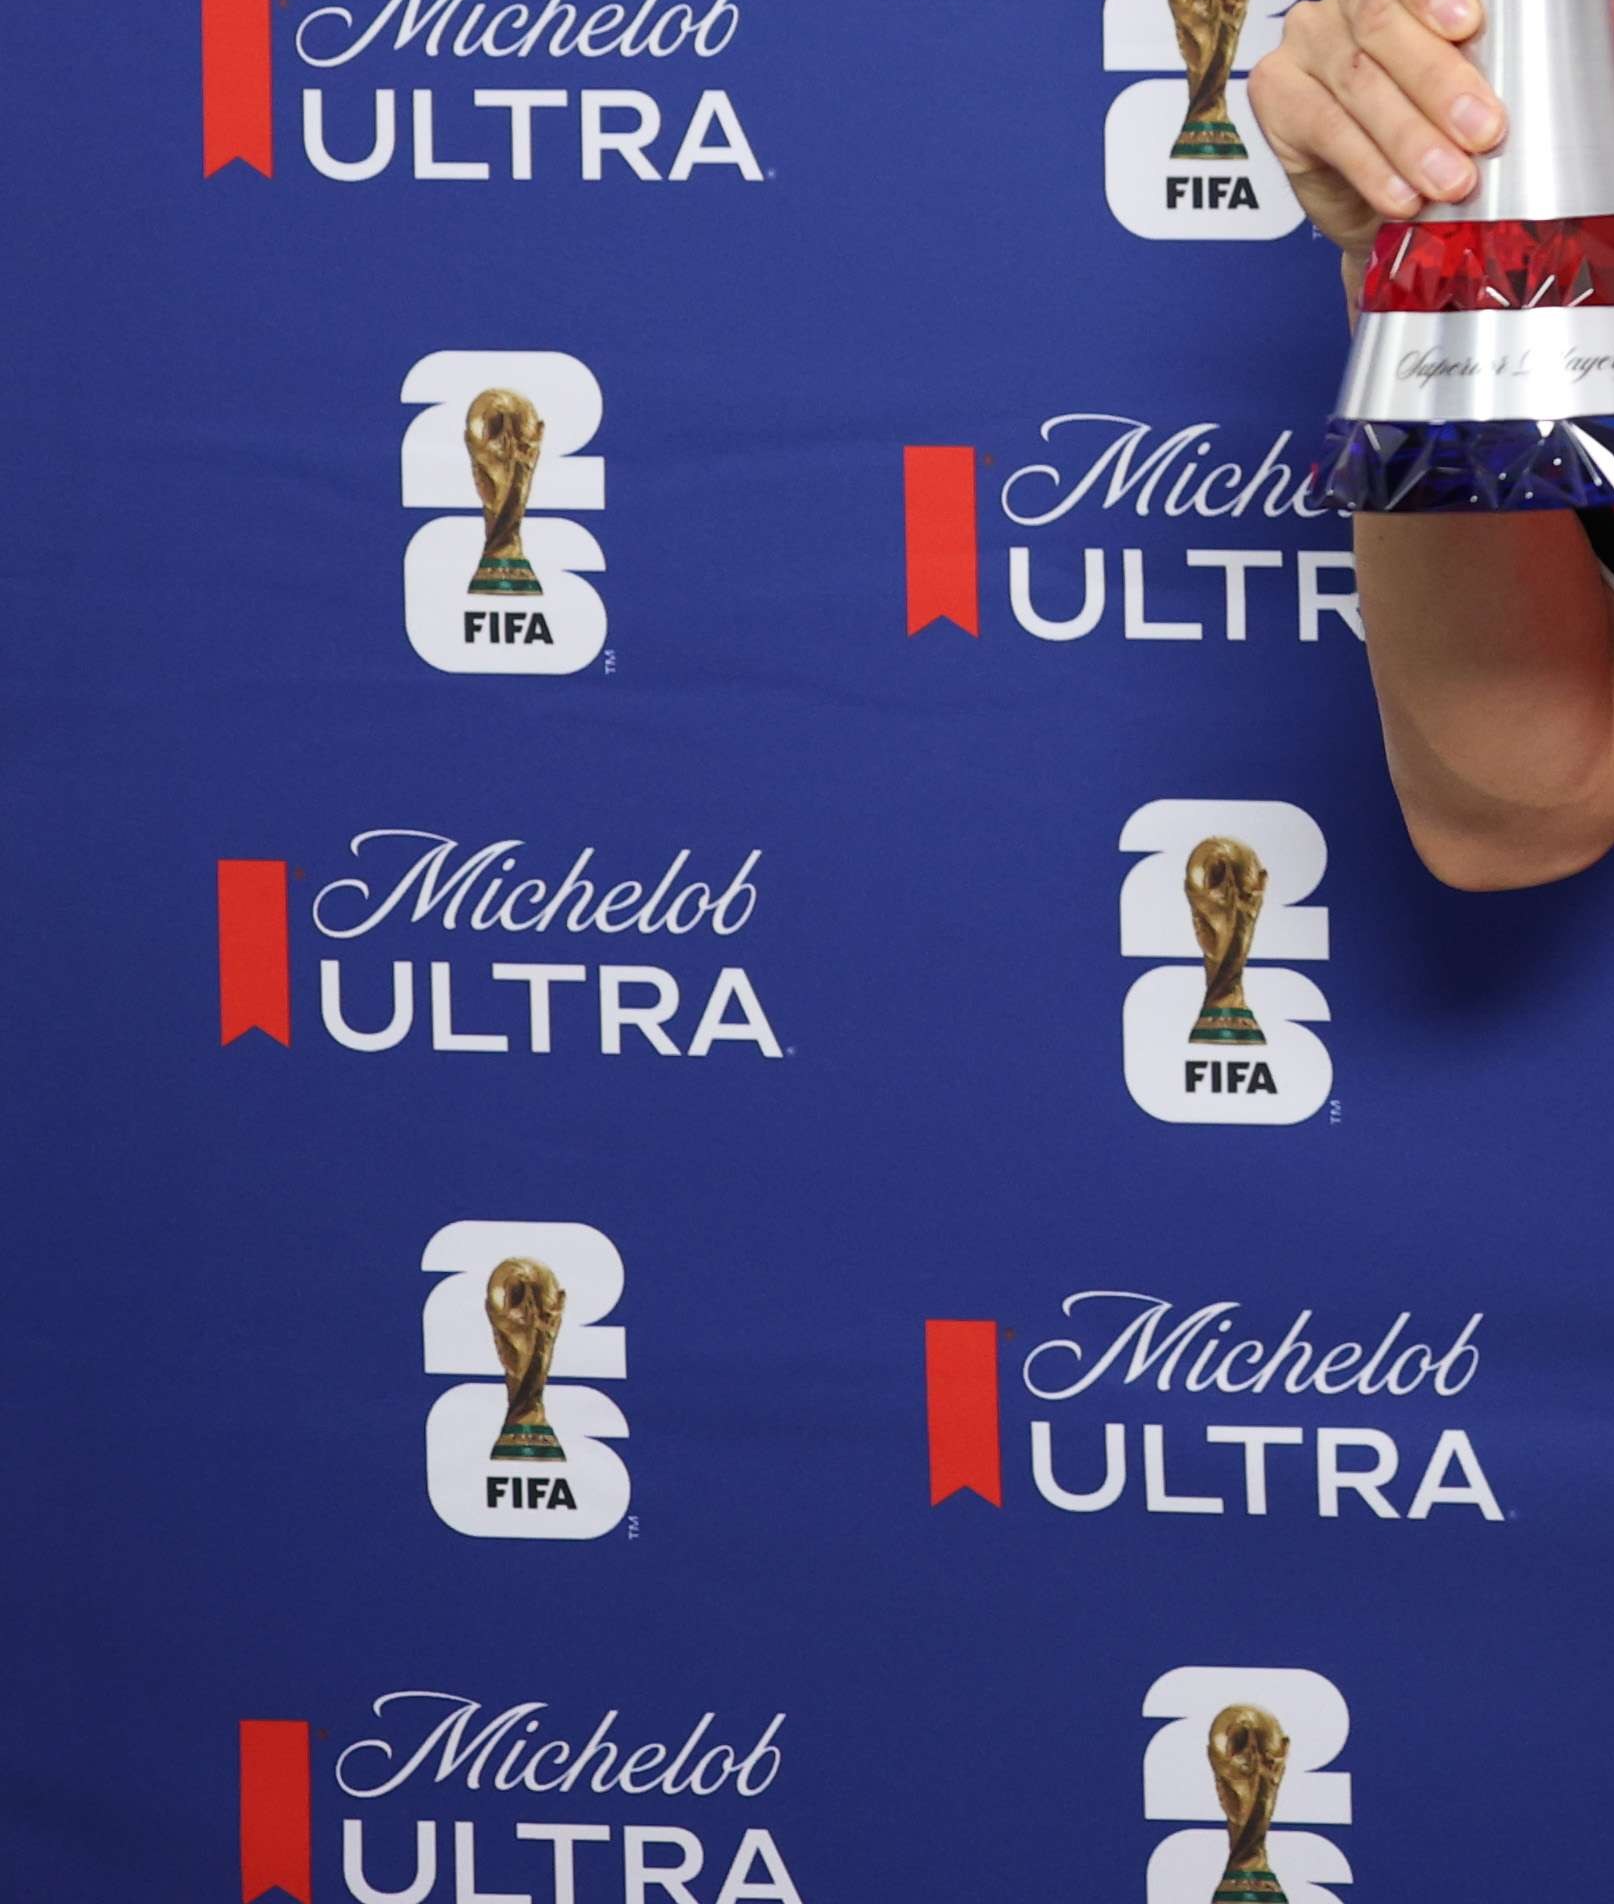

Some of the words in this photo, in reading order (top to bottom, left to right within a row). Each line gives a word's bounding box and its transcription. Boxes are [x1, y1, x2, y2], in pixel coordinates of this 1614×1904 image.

[302, 88, 766, 182] ULTRA
[1166, 176, 1260, 210] FIFA
[464, 610, 555, 646] FIFA
[1009, 535, 1364, 642] ULTR
[312, 828, 764, 940] Michelob
[320, 959, 785, 1059] ULTRA
[1185, 1059, 1278, 1095] FIFA
[1022, 1290, 1485, 1402] Michelob
[486, 1475, 578, 1511] FIFA
[1030, 1420, 1506, 1522] ULTRA
[335, 1690, 788, 1799] Michelob
